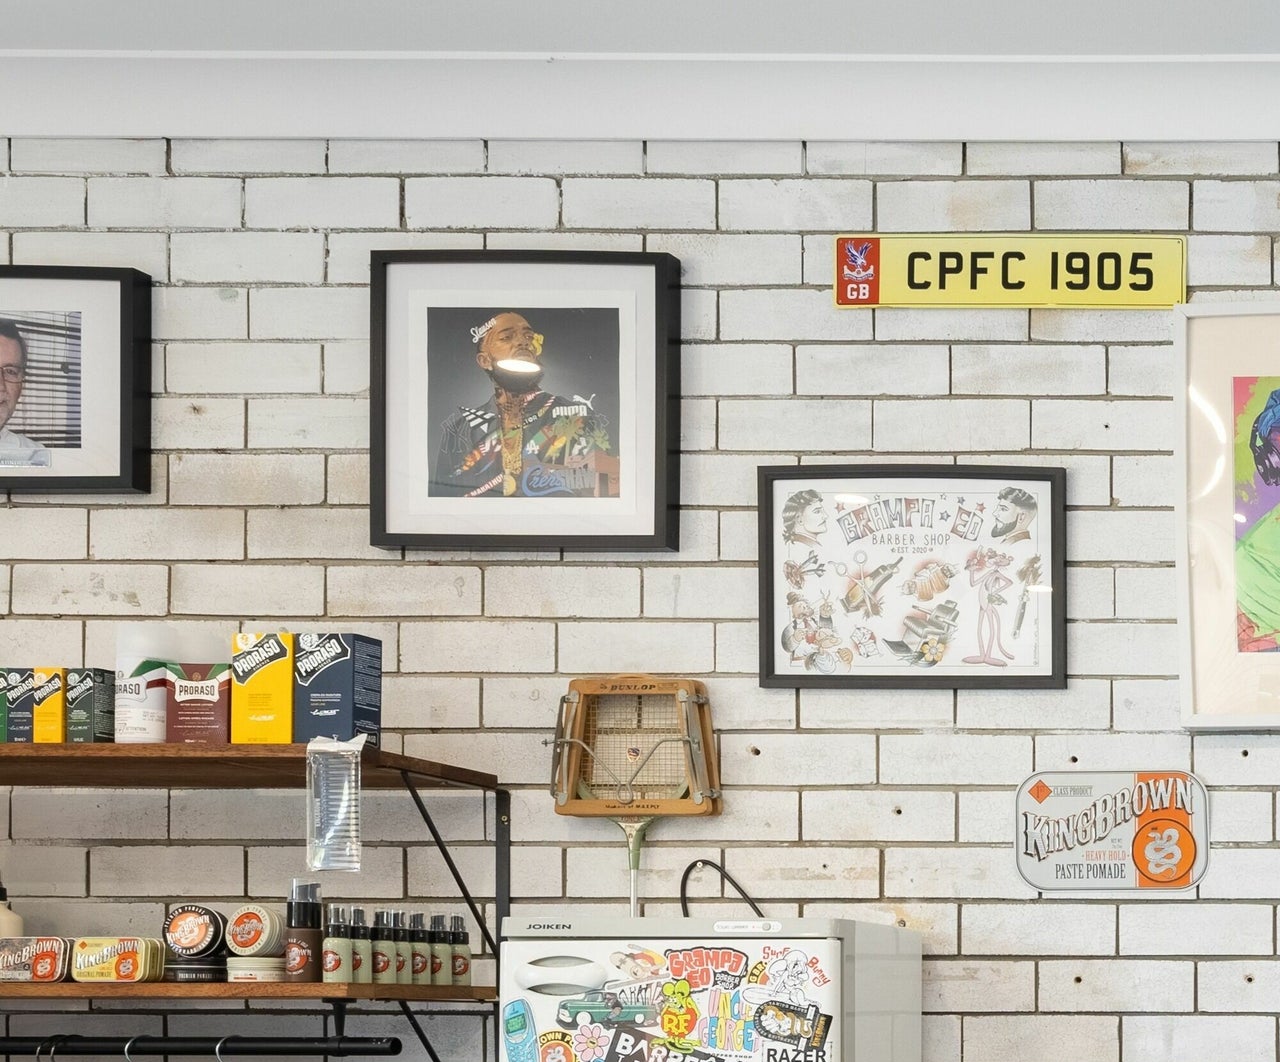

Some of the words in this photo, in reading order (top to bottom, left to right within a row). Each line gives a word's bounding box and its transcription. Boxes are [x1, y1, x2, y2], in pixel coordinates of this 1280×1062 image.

[907, 251, 1026, 291] CPFC
[1051, 251, 1153, 291] 1905
[847, 284, 869, 299] GB
[552, 405, 587, 418] PUMA
[950, 506, 985, 541] ED
[872, 533, 915, 545] BARBER
[924, 533, 950, 545] SHOP
[233, 638, 281, 677] PRORASO
[296, 638, 342, 677] PRORASO
[66, 677, 93, 702] PRORASO
[178, 684, 215, 696] PRORASO
[1054, 787, 1070, 796] CLASS
[1070, 786, 1092, 796] PRODUCT
[1085, 851, 1106, 861] HEAVY
[1108, 851, 1127, 861] HOLD
[1055, 864, 1084, 880] PASTE
[1087, 863, 1126, 879] POMADE
[708, 989, 755, 1021] UNCLE
